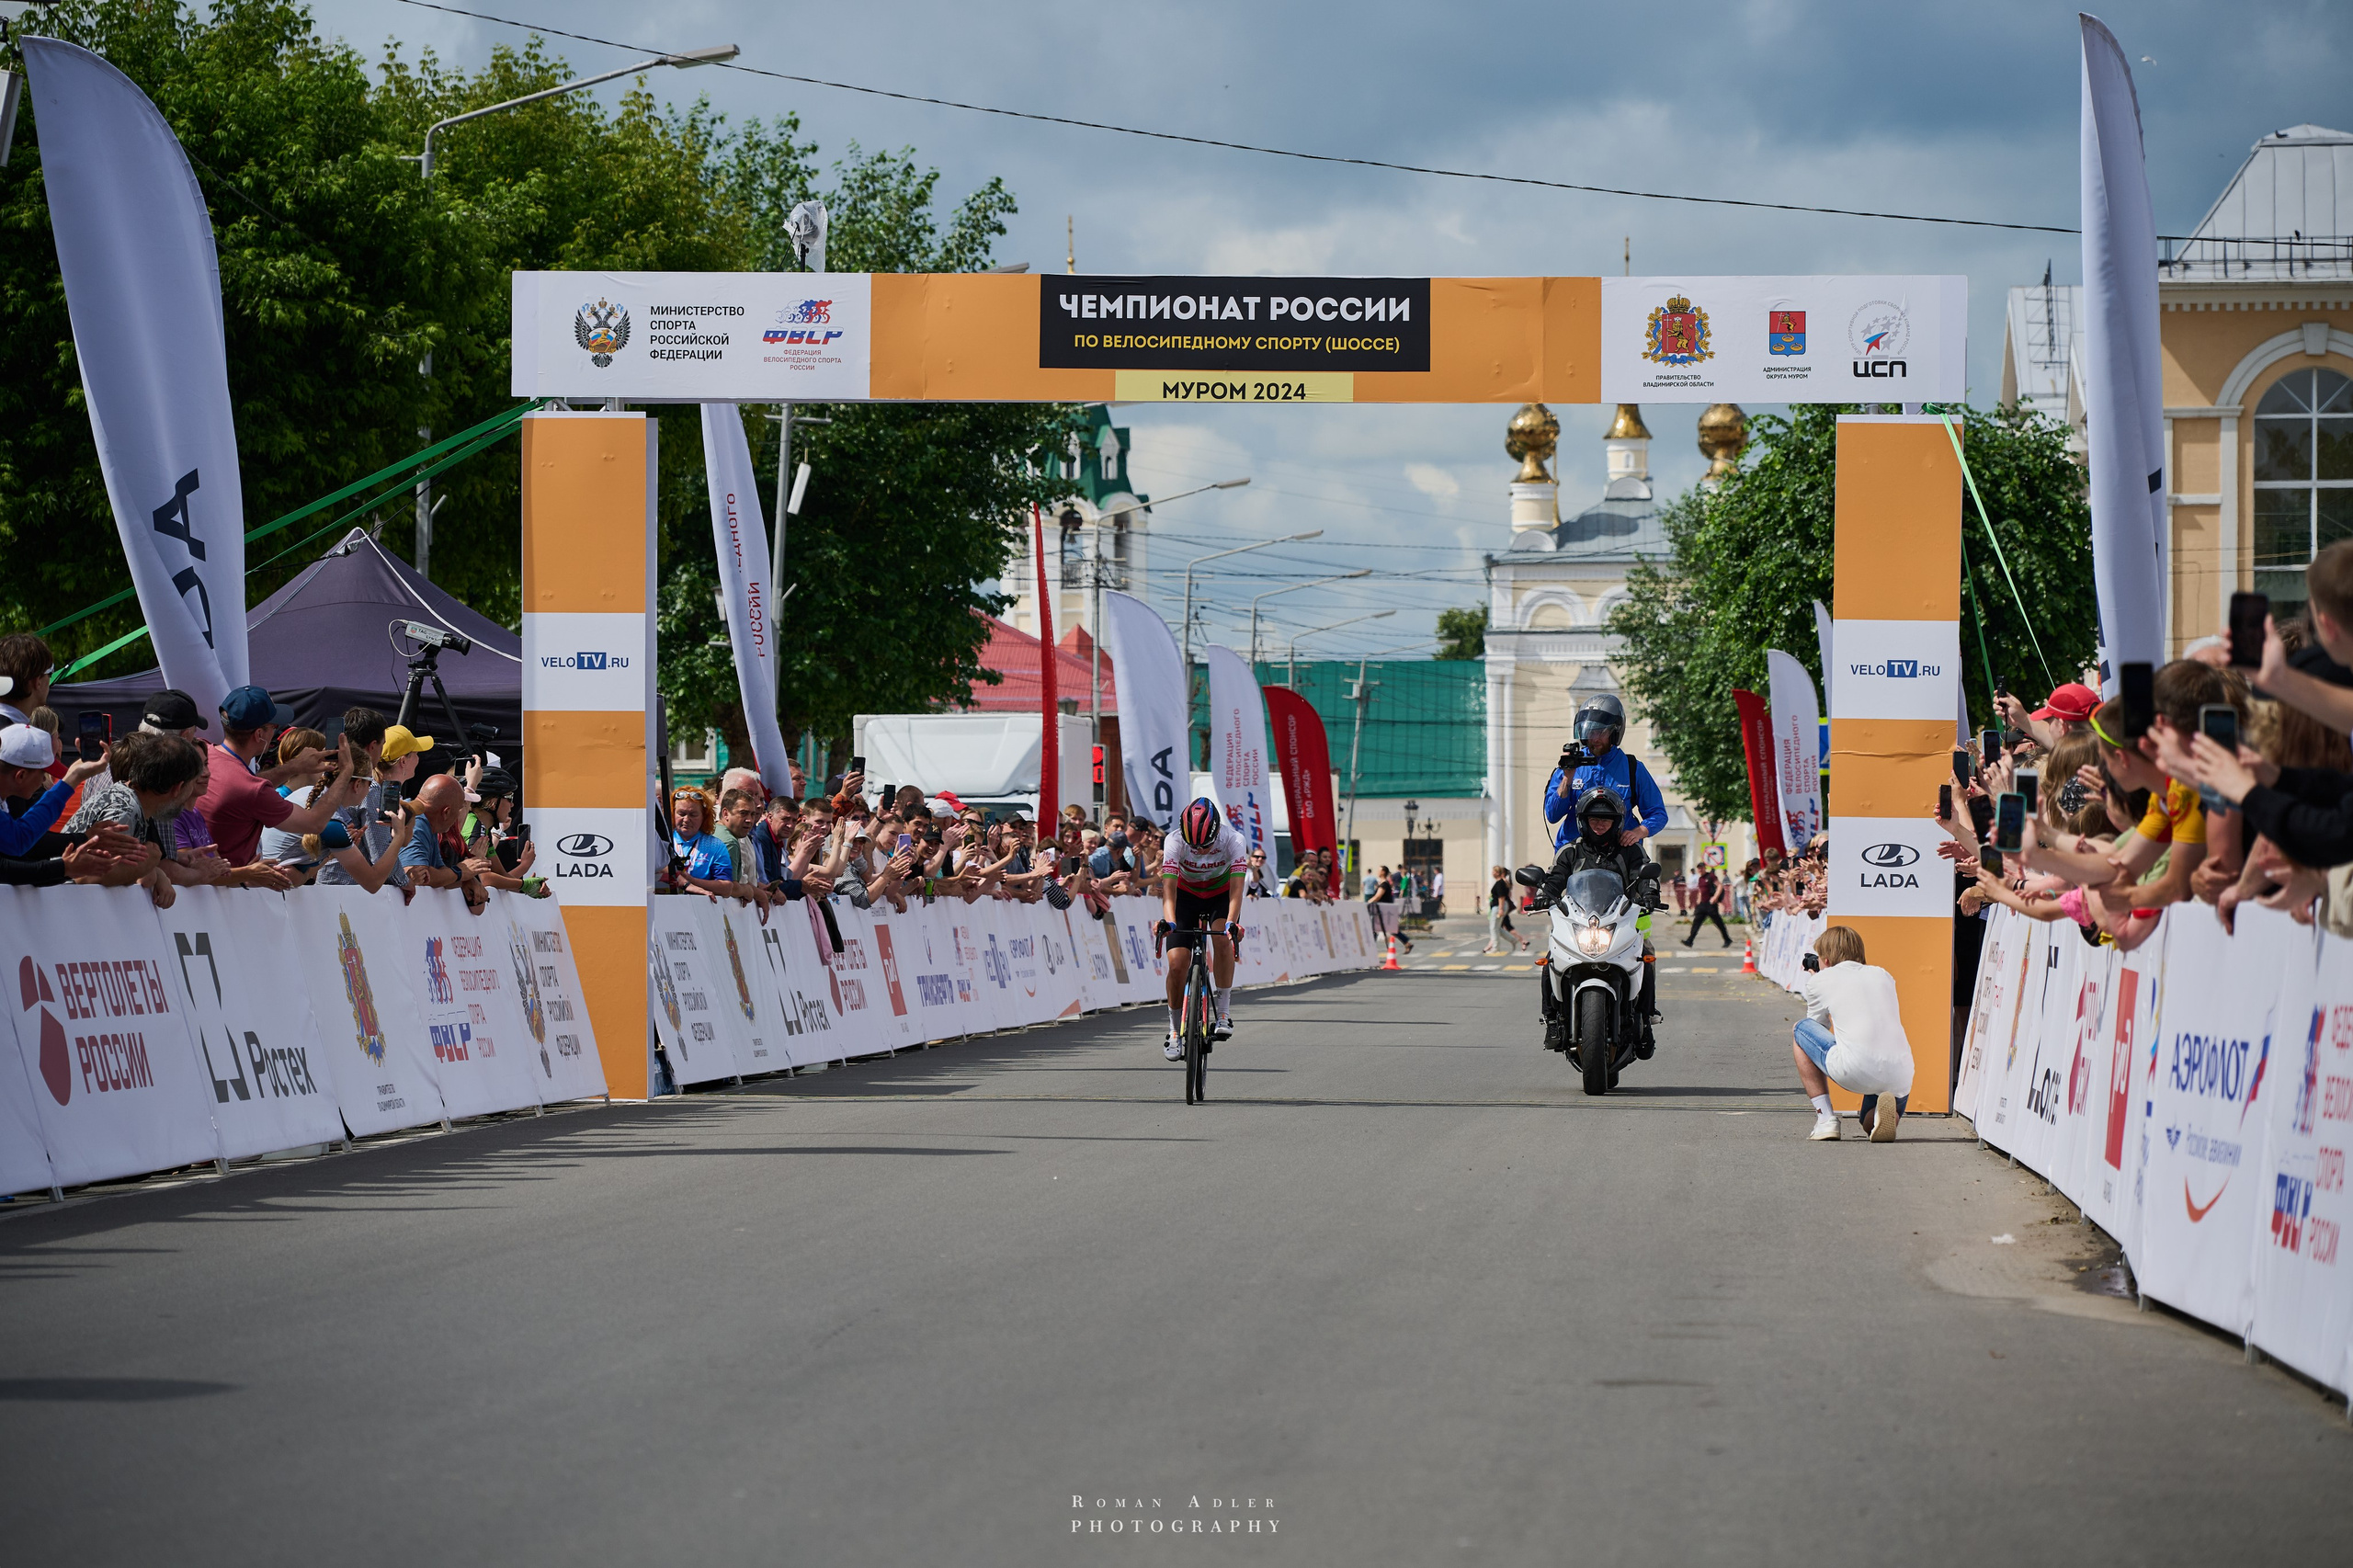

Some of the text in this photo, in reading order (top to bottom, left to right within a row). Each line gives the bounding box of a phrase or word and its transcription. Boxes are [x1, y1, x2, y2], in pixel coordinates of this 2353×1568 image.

[650, 305, 745, 317] МИНИСТЕРСТВО
[1059, 293, 1410, 322] ЧЕМПИОНАТ РОССИИ
[650, 320, 697, 331] СПОРТА
[650, 332, 730, 346] РОССИЙСКОЙ
[1074, 335, 1401, 353] ПО ВЕЛОСИПЕДНОМУ СПОРТУ (ШОССЕ)
[650, 347, 722, 361] ФЕДЕРАЦИИ
[1763, 366, 1812, 374] АДМИНИСТРАЦИЯ
[1853, 360, 1907, 378] ЦСП
[1163, 381, 1306, 400] МУРОМ 2024
[1225, 733, 1233, 790] ФЕДЕРАЦИЯ
[1791, 714, 1802, 794] ВЕЛОСИПЕДНОГО
[1784, 738, 1793, 795] ФЕДЕРАЦИЯ
[1803, 757, 1812, 793] СПОРТА
[556, 863, 614, 878] LADA
[1860, 872, 1920, 889] LADA
[55, 960, 170, 1020] ВЕРТОЛЕТЫ
[75, 1032, 154, 1094] РОССИИ
[244, 1031, 318, 1099] Ростех
[2168, 1032, 2250, 1102] АЭРОФЛОТ
